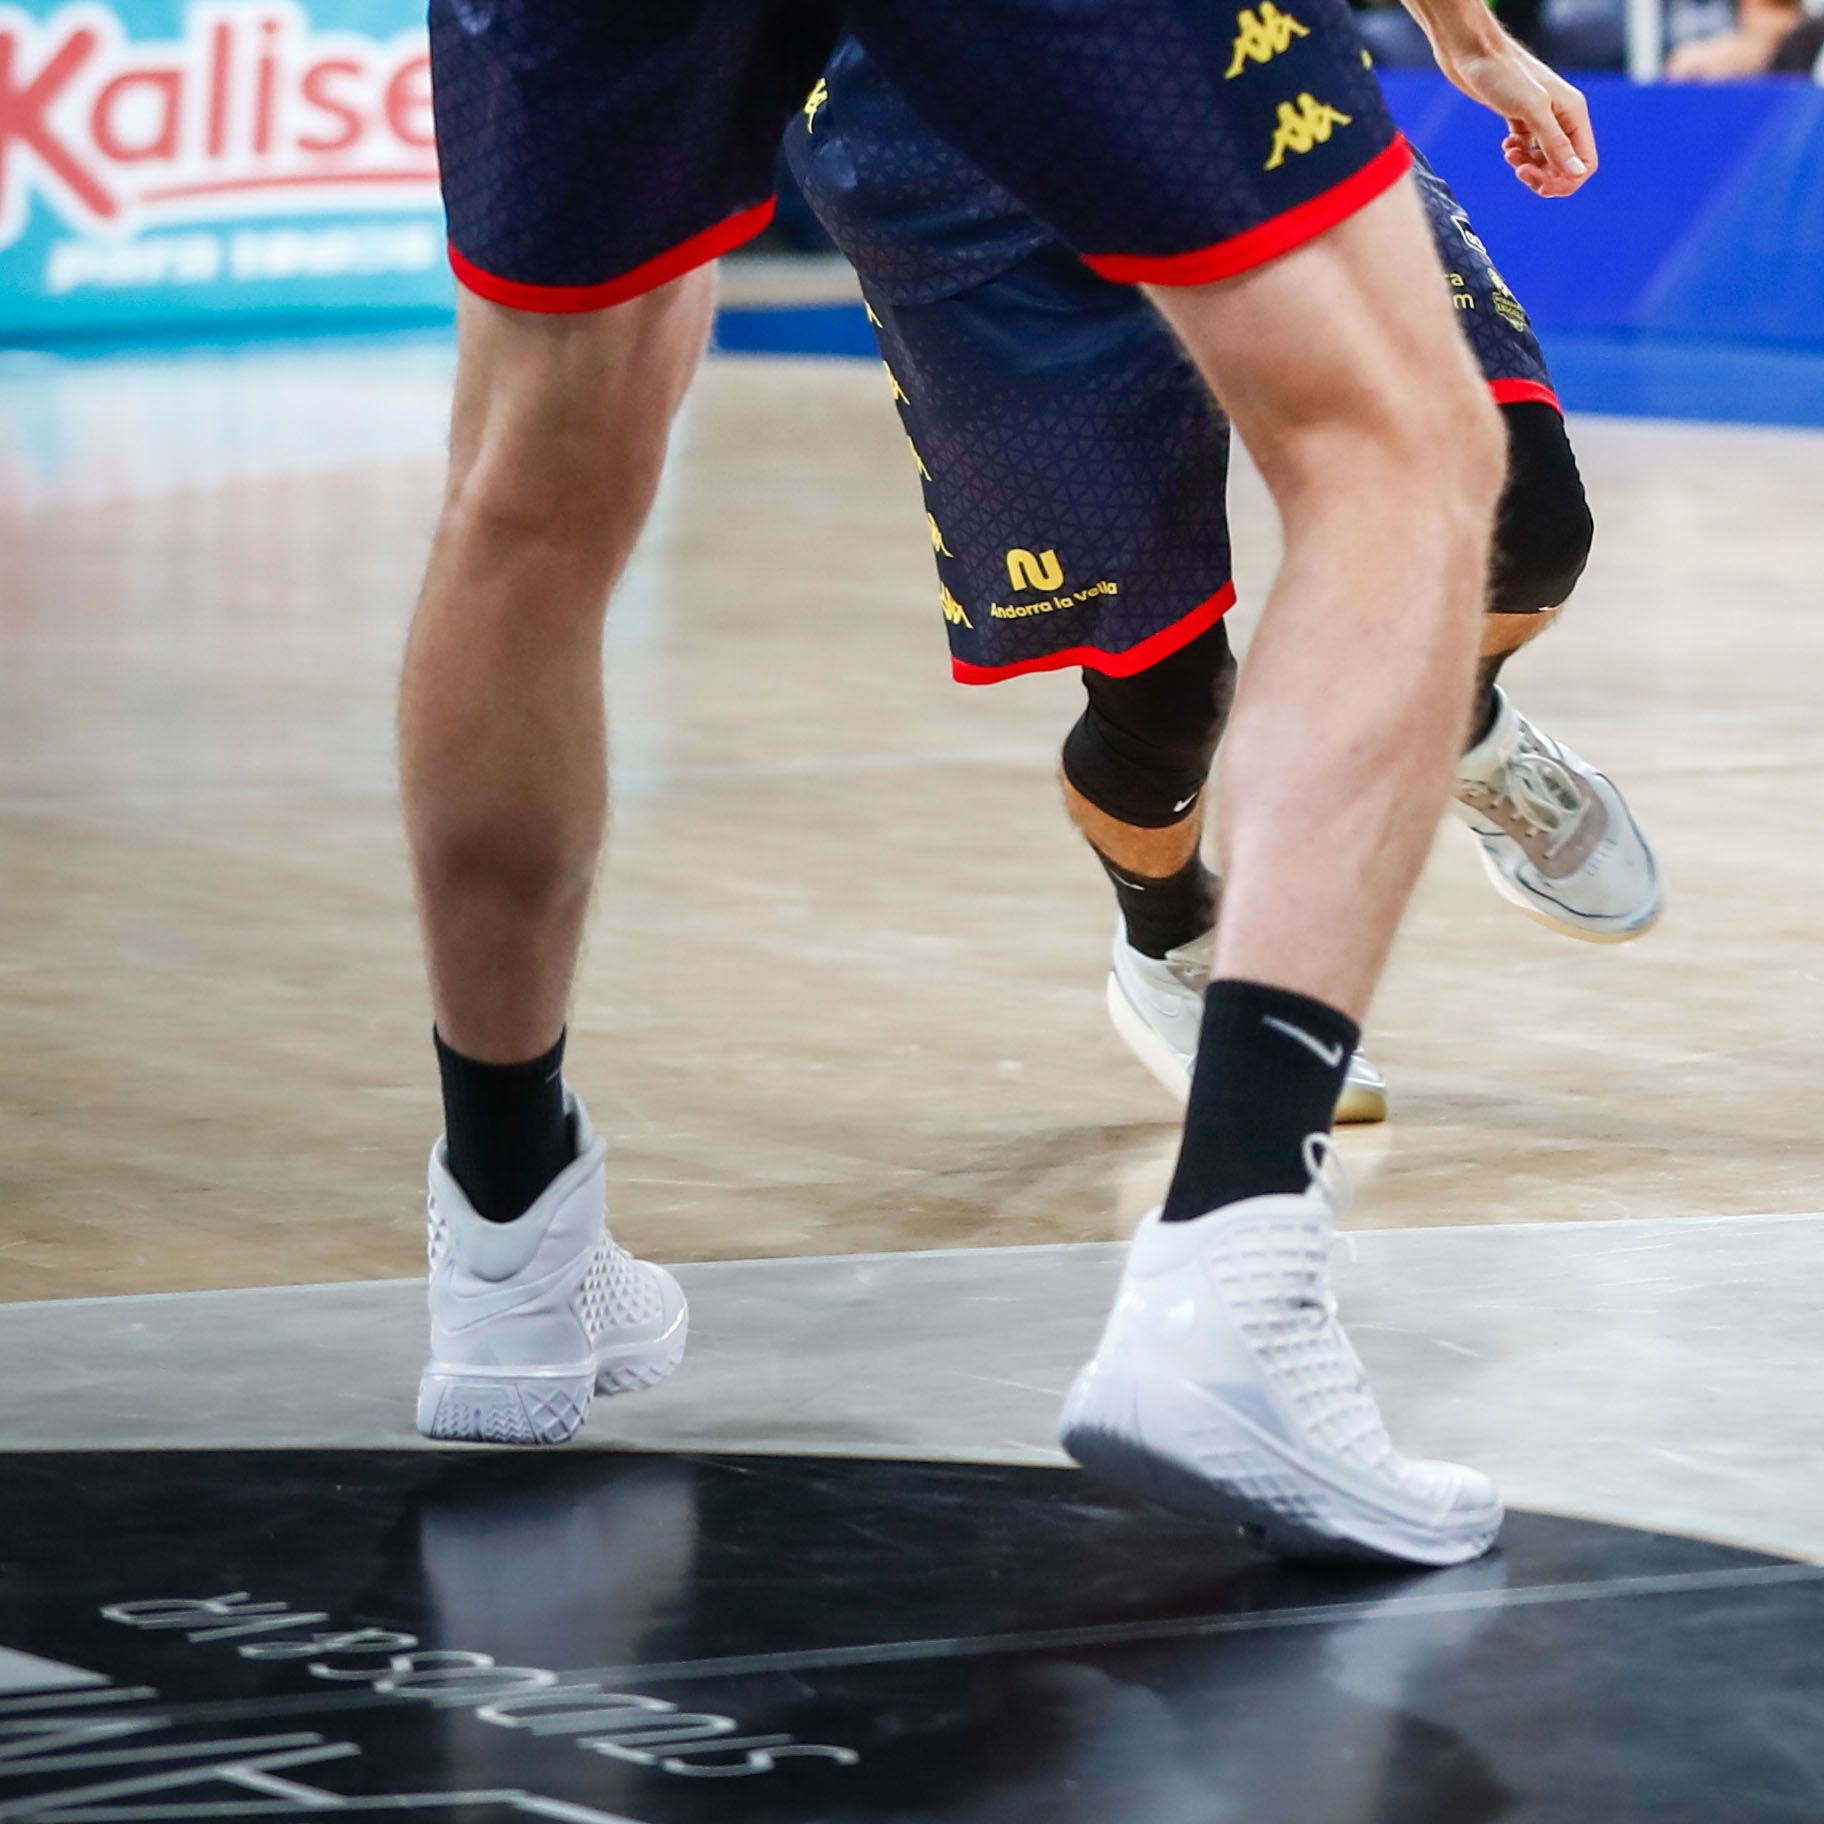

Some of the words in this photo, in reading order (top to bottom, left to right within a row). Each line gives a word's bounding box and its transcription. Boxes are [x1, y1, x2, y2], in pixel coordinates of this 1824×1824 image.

[0, 20, 437, 222] Kalise
[990, 600, 1052, 619] Andorra
[1053, 596, 1074, 610] la
